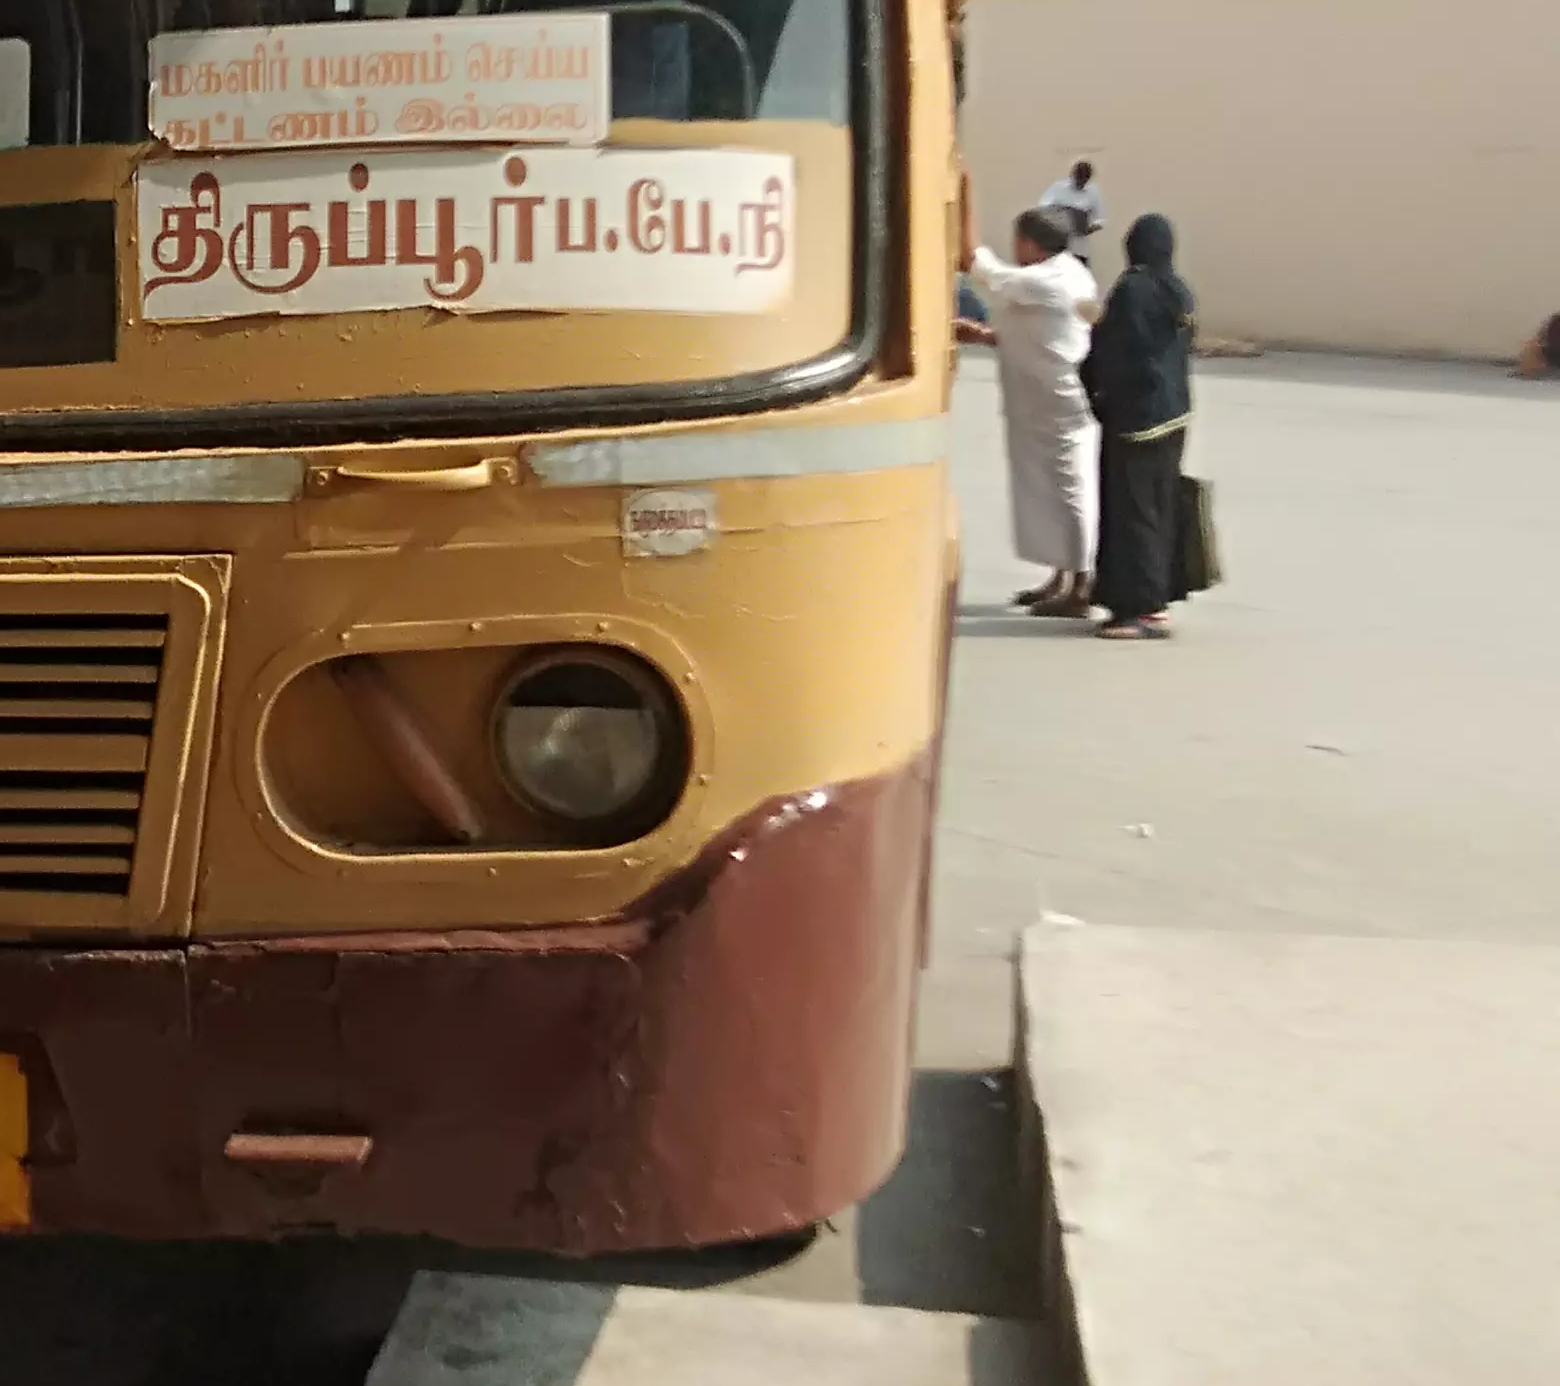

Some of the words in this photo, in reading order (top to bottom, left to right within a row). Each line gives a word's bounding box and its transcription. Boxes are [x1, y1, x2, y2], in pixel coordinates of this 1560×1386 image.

[161, 40, 289, 96] மகளிர்
[302, 35, 453, 89] பயணம்
[465, 30, 591, 81] செய்ய
[164, 96, 378, 145] கட்டணம்
[393, 92, 588, 135] இல்லை
[143, 156, 546, 300] திருப்பூர்
